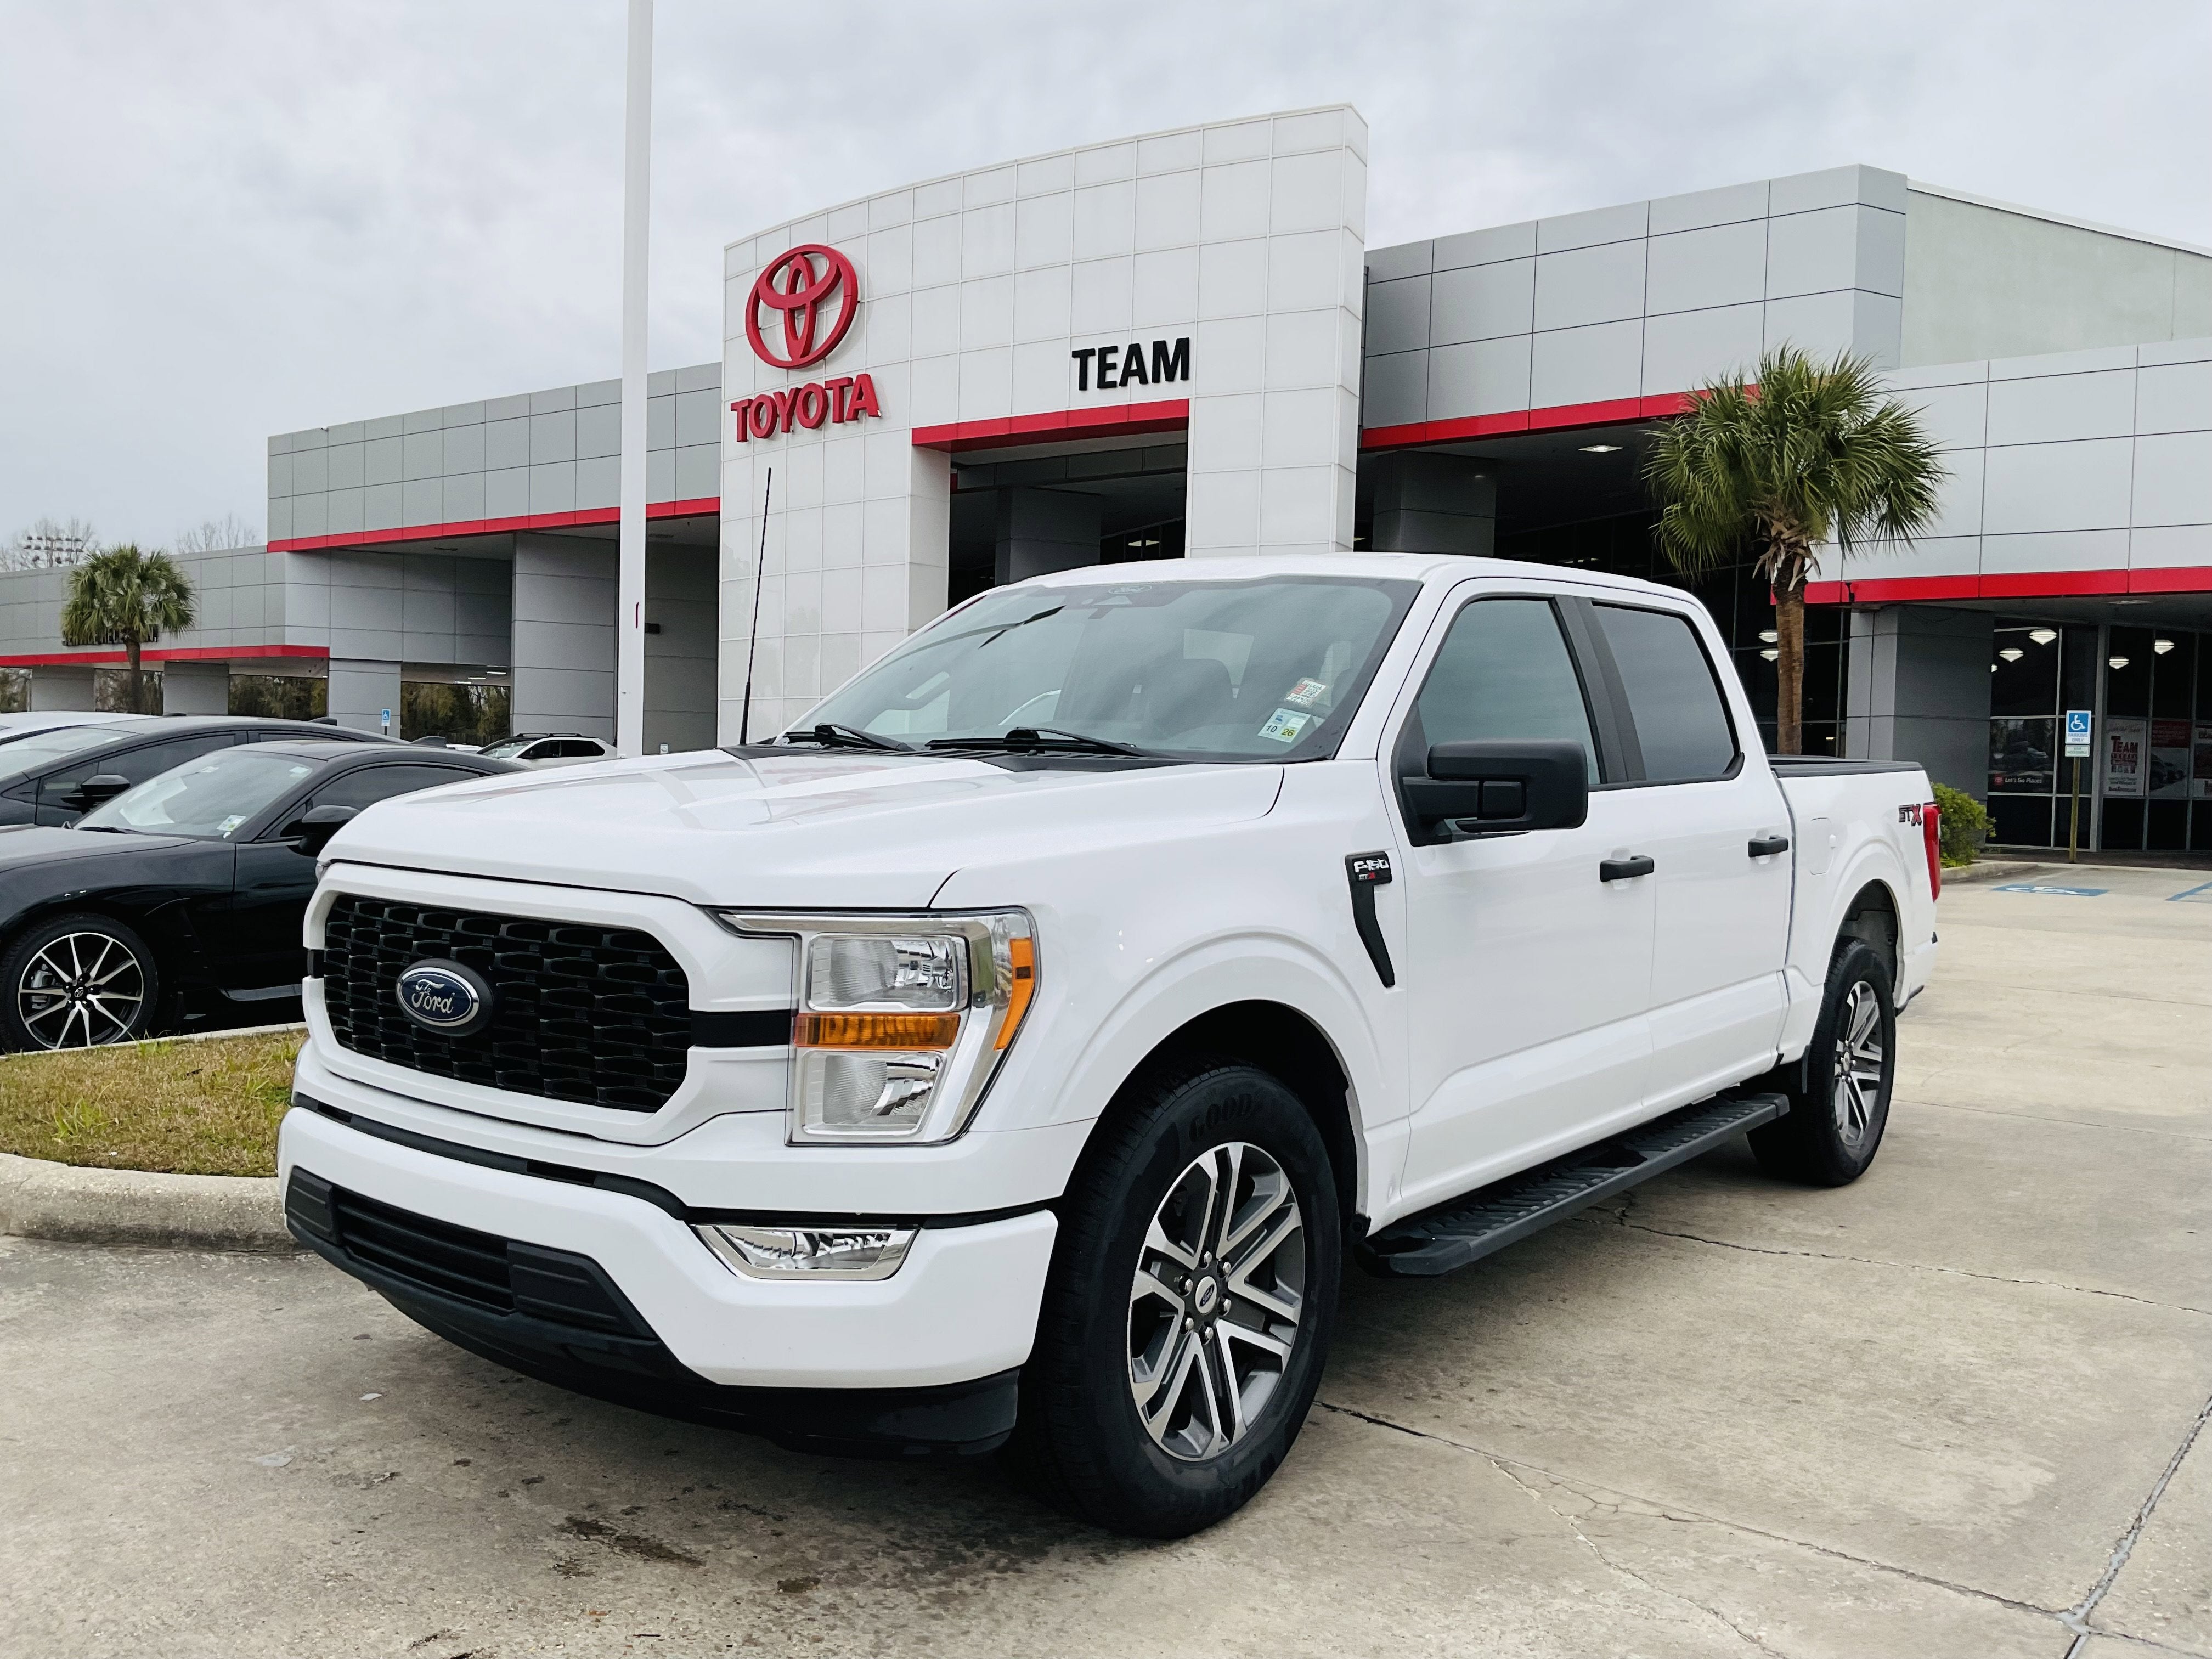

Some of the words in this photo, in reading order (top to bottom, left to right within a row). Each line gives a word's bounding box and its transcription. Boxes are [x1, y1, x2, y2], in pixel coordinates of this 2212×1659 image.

[1071, 337, 1189, 391] TEAM
[731, 374, 881, 443] TOYOTA
[1266, 724, 1277, 733] 10
[1281, 728, 1295, 736] 26
[1898, 803, 1922, 827] STX
[1353, 859, 1389, 873] F-150
[411, 978, 455, 1014] Ford
